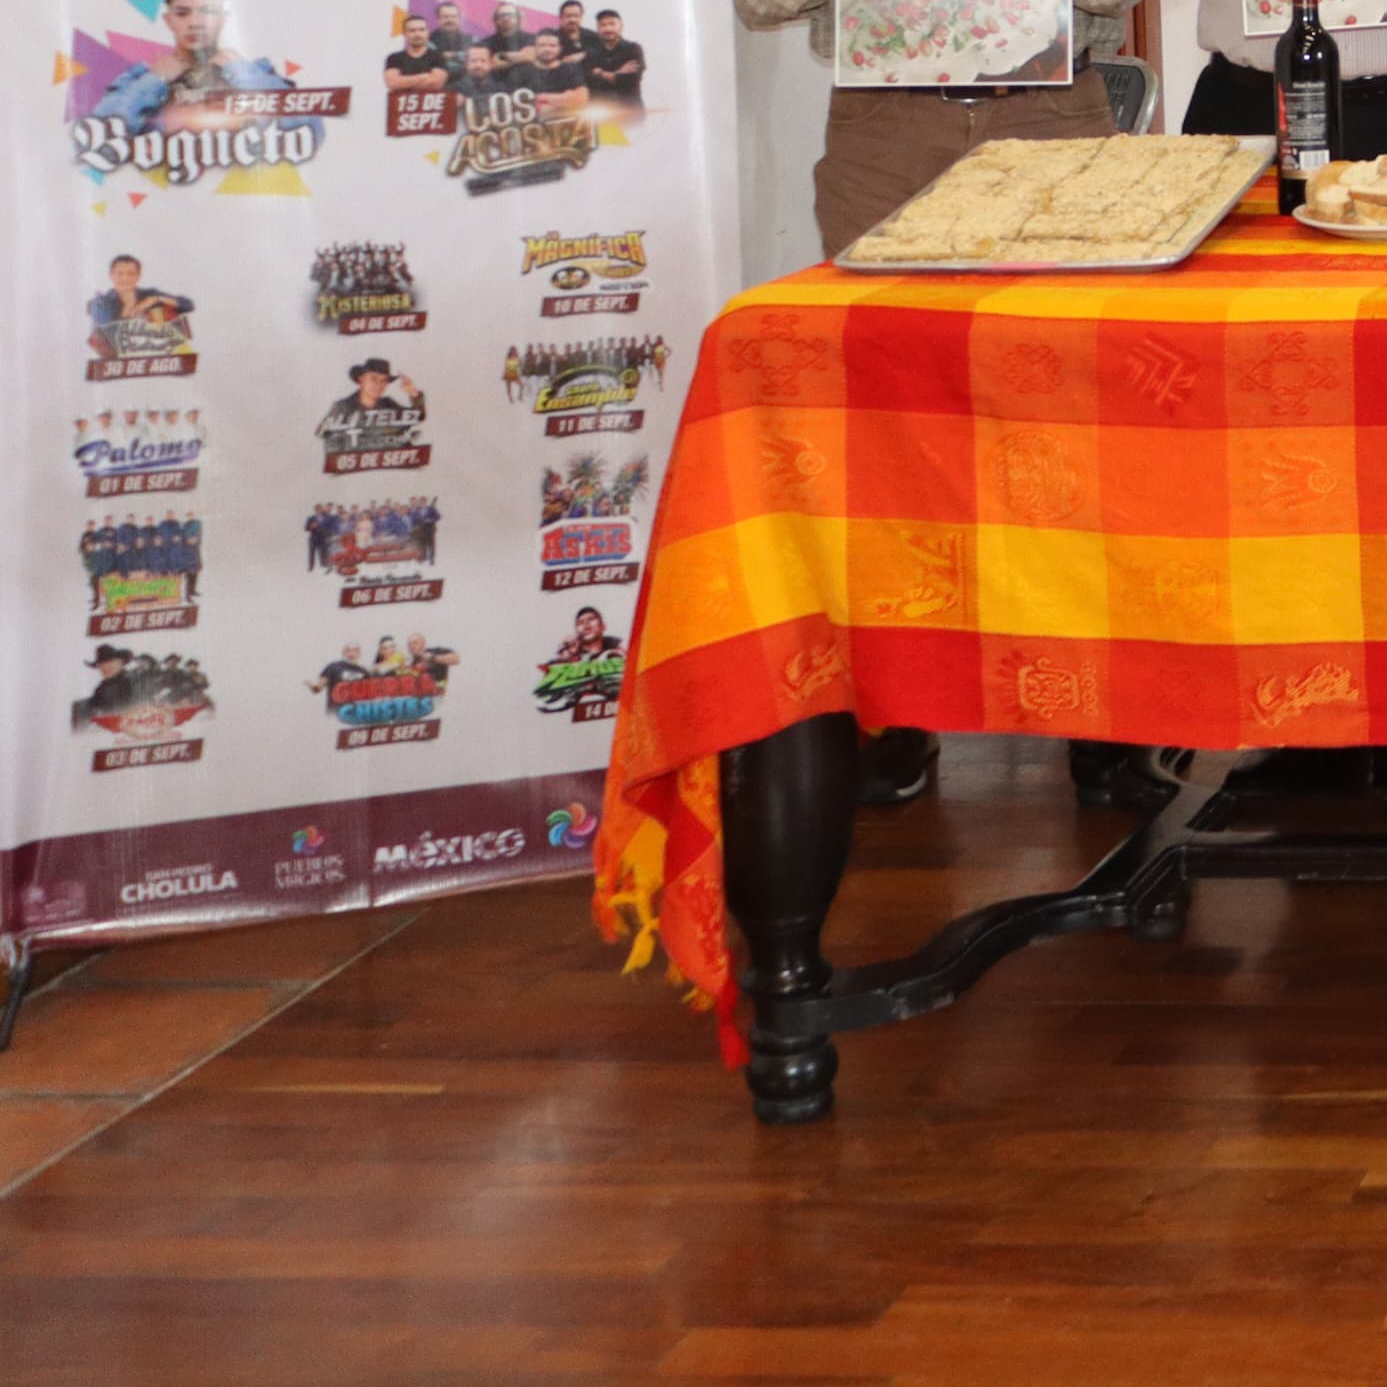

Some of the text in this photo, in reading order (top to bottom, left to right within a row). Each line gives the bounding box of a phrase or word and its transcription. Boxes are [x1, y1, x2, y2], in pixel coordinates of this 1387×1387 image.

[254, 93, 277, 112] DE
[283, 92, 336, 112] SEPT.
[398, 94, 446, 111] 15 DE
[466, 88, 537, 132] LOS
[398, 114, 443, 130] SEPT.
[121, 871, 238, 903] CHOLULA
